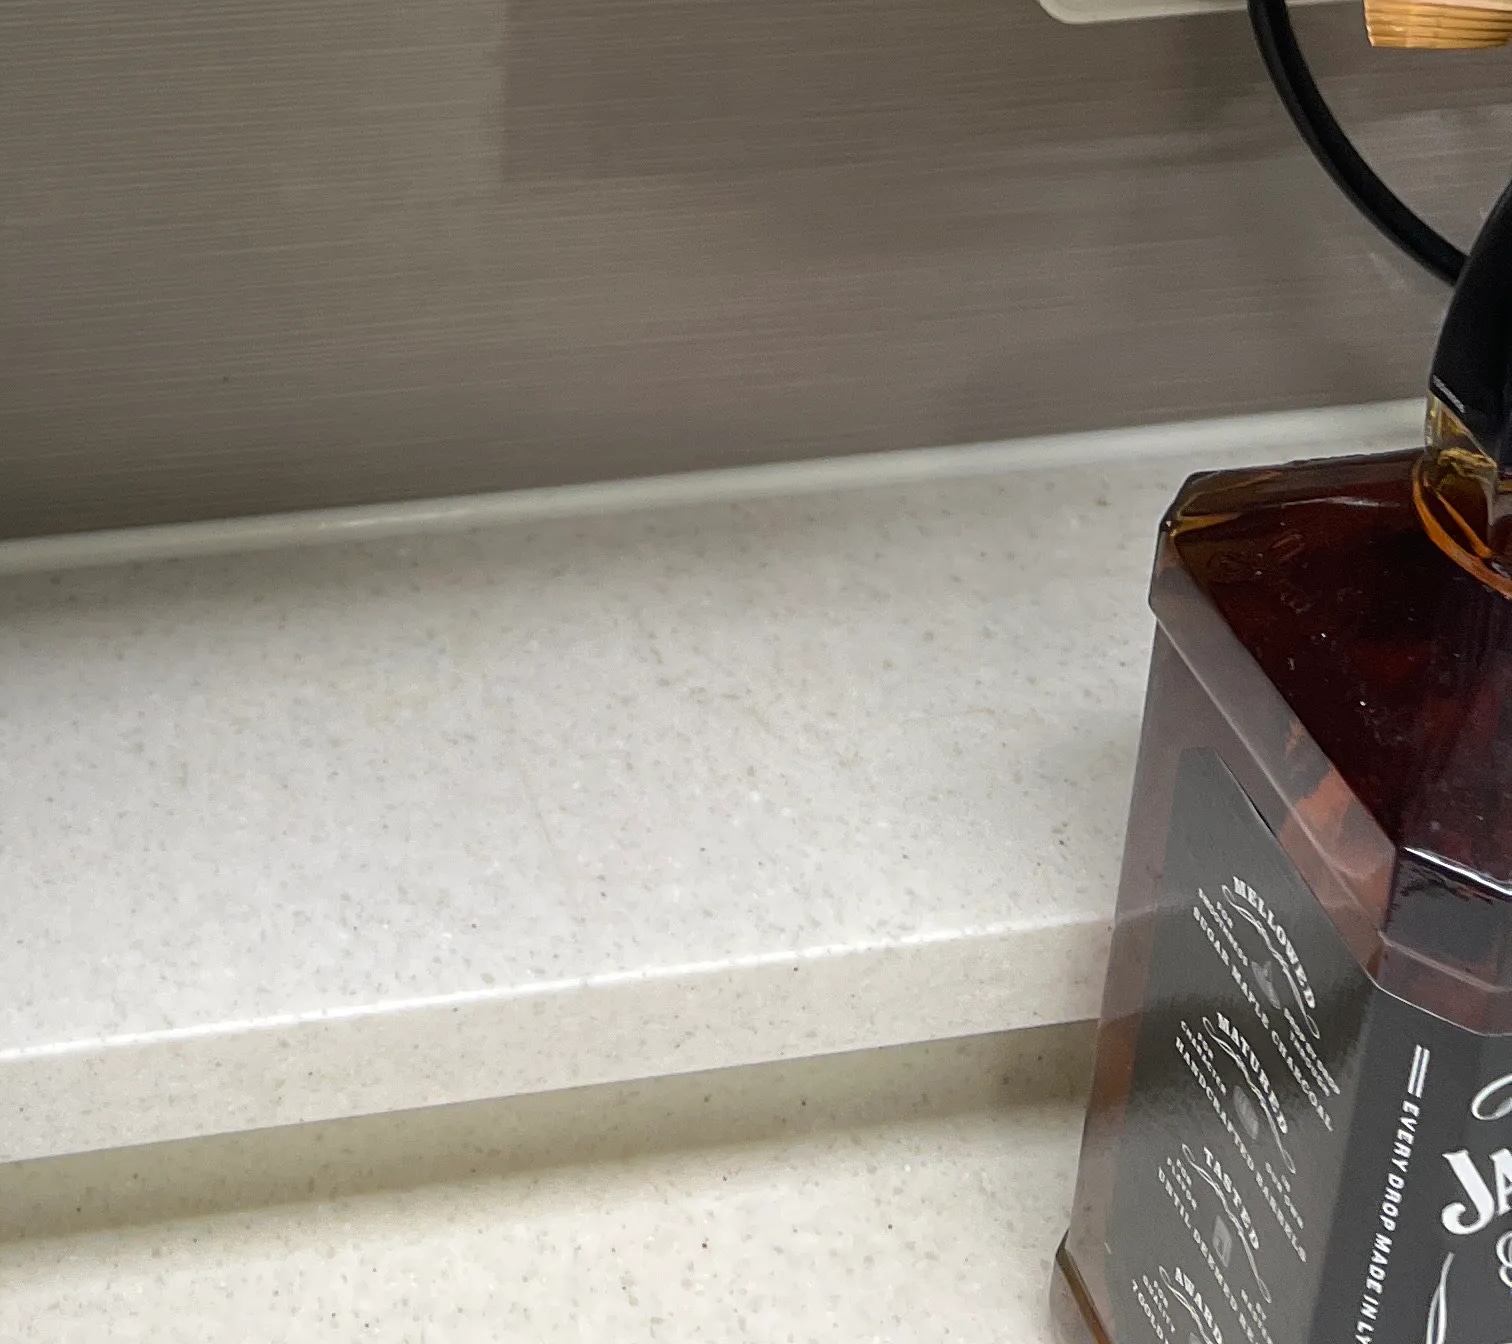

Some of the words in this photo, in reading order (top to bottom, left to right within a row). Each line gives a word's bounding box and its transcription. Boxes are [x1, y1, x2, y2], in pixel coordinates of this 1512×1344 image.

[1233, 876, 1316, 1009] MELLOWED
[1193, 906, 1230, 967] SUGAR
[1232, 963, 1269, 1030] MAPLE
[1271, 1030, 1334, 1132] CHARCOAL
[1217, 1012, 1288, 1134] MATURED
[1175, 1036, 1255, 1172] HANDCRAFTED
[1256, 1171, 1307, 1262] BARRELS
[1391, 1100, 1420, 1173] EVERY
[1158, 1166, 1192, 1230] UNTIL
[1193, 1228, 1238, 1312] DEEMED
[1203, 1146, 1260, 1250] TASTED
[1379, 1173, 1405, 1232] DROP
[1360, 1294, 1379, 1321] IN
[1365, 1232, 1393, 1294] MADE
